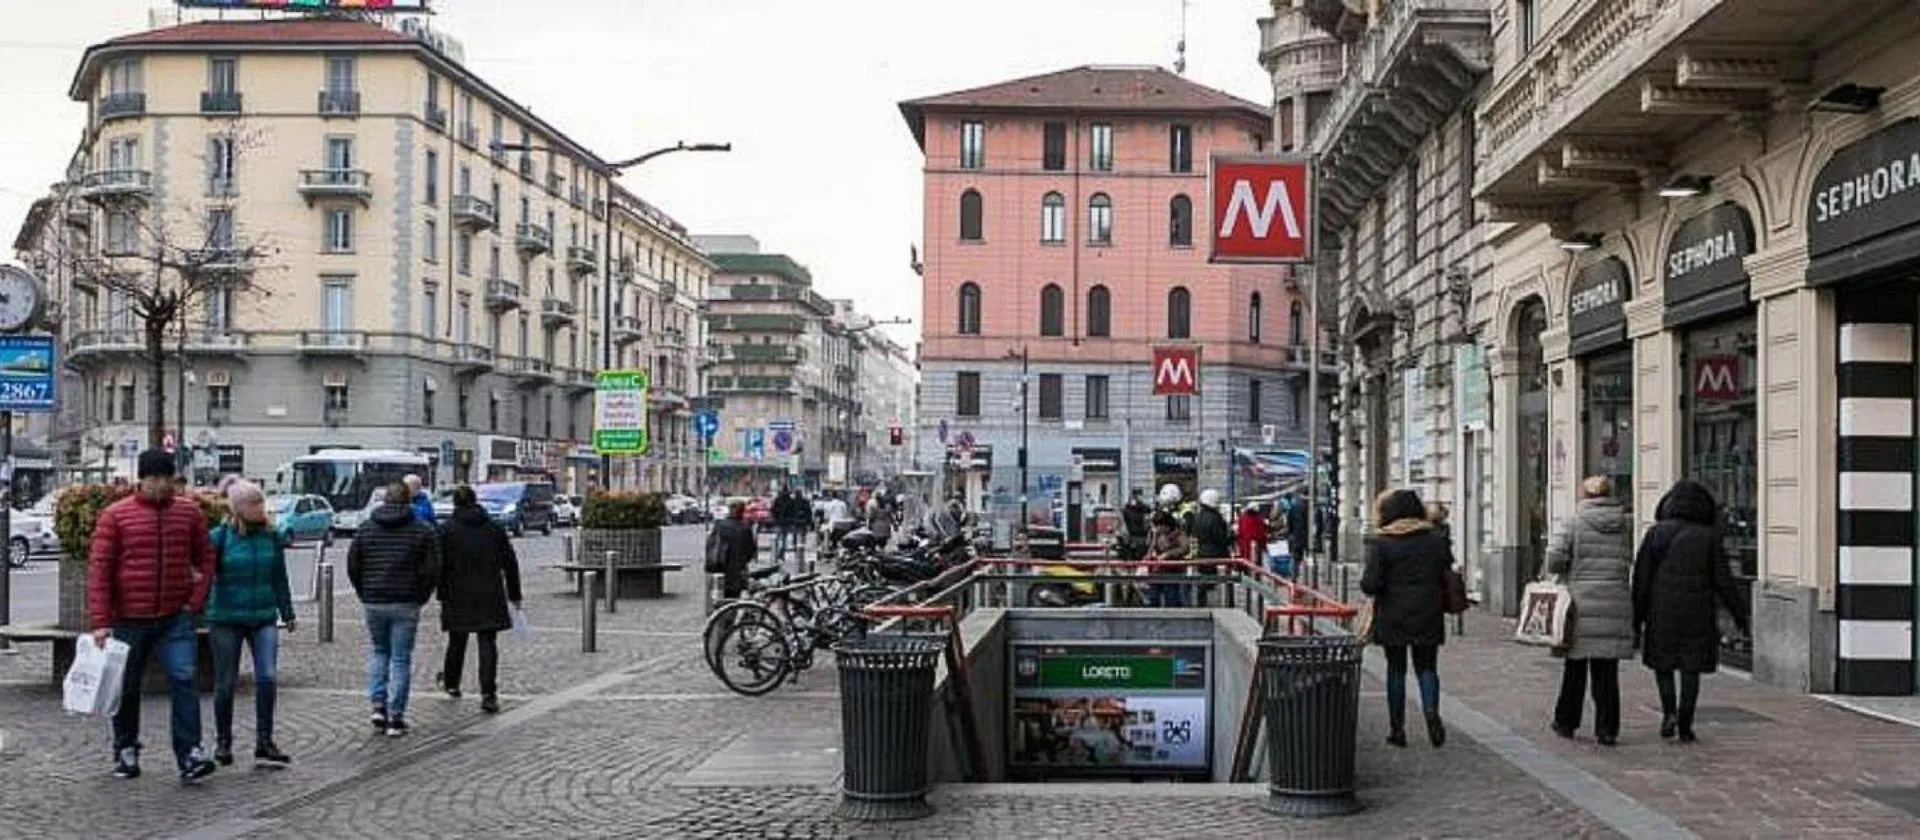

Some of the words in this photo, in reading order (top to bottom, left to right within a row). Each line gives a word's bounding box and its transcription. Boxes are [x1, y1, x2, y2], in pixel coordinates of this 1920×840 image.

[1816, 152, 1920, 222] SEPHORA
[1219, 180, 1301, 238] M
[1669, 230, 1737, 278] SEPHORA
[1572, 279, 1618, 317] SEPHORA
[1157, 358, 1193, 385] M
[1698, 362, 1735, 392] M
[1082, 664, 1132, 679] LORETO
